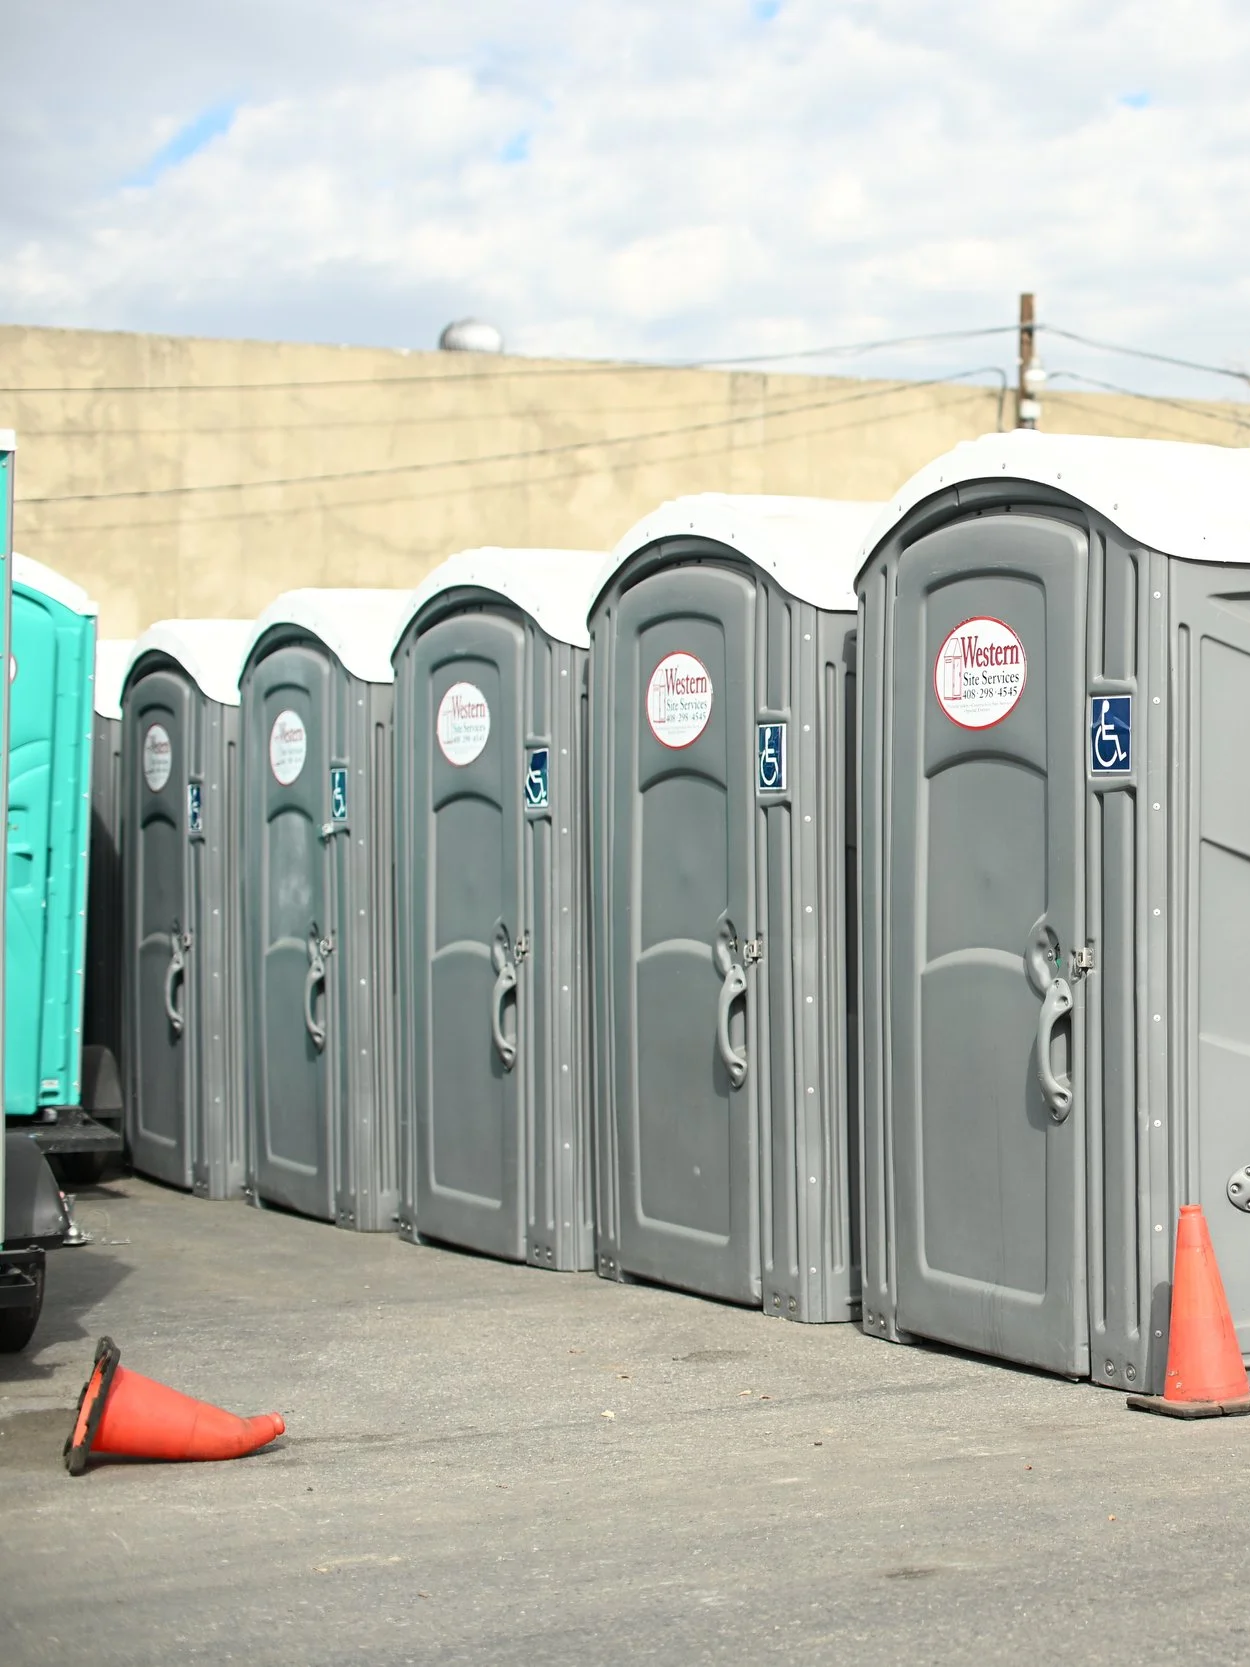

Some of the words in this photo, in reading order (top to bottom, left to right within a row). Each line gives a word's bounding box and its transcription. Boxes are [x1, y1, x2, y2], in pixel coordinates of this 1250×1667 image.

[960, 635, 1020, 668] Western
[665, 667, 707, 696] Western
[963, 671, 980, 687] Site
[981, 670, 1020, 686] Services
[451, 695, 486, 720] Western
[680, 697, 708, 711] Services
